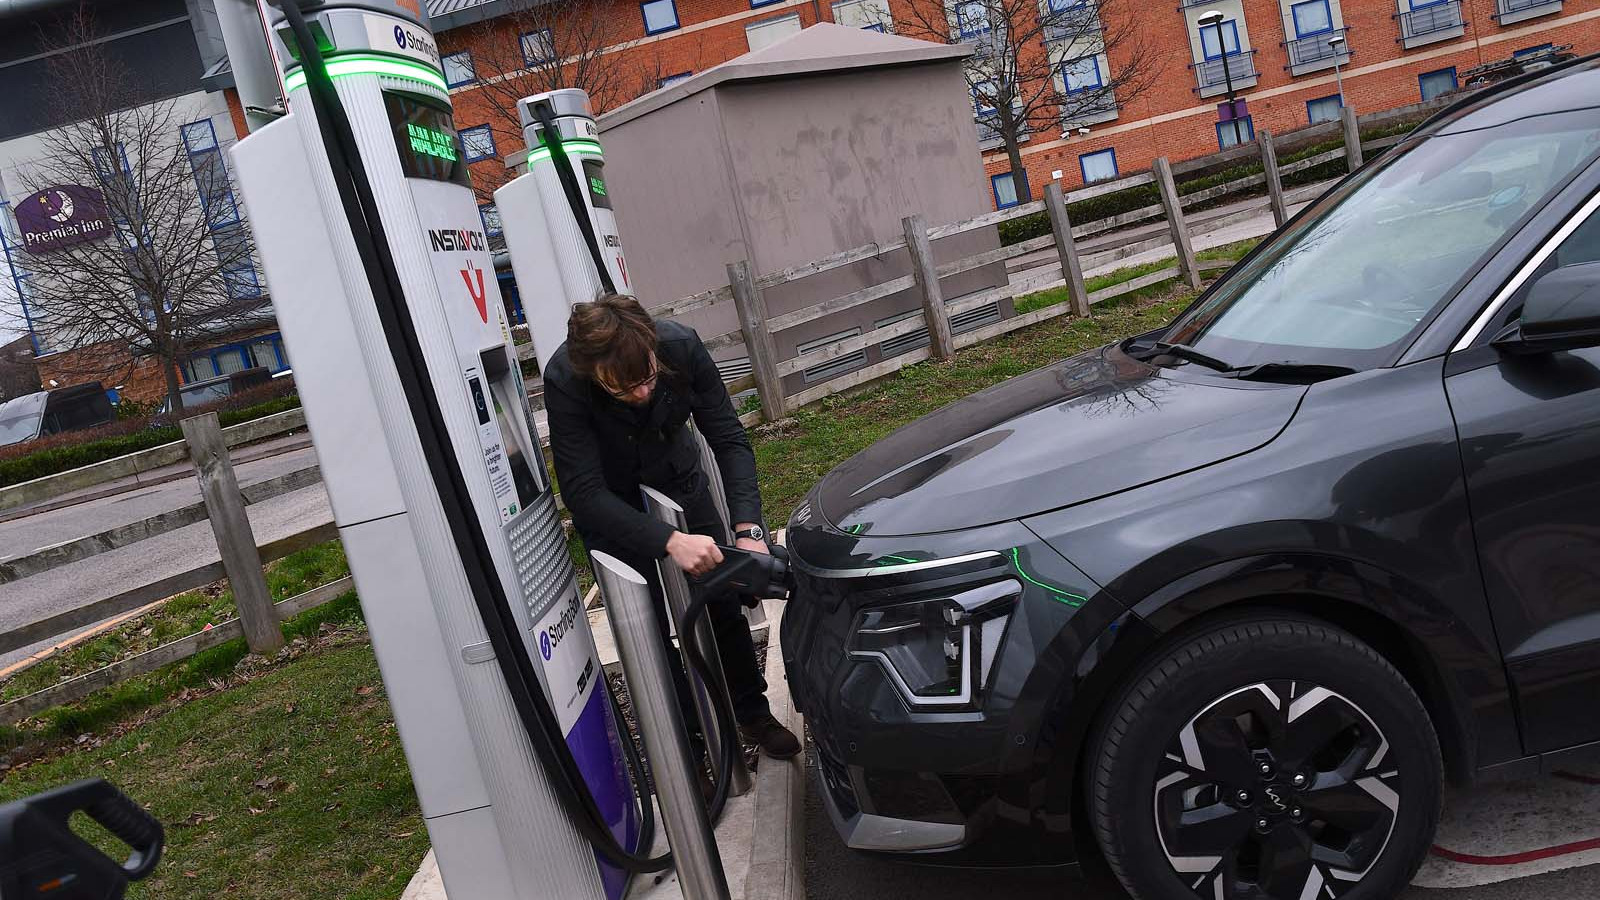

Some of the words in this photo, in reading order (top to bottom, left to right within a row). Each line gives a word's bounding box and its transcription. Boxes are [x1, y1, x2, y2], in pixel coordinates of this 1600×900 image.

[26, 224, 79, 246] Premier
[428, 229, 485, 252] INSTAVOLT
[549, 609, 574, 648] Starling
